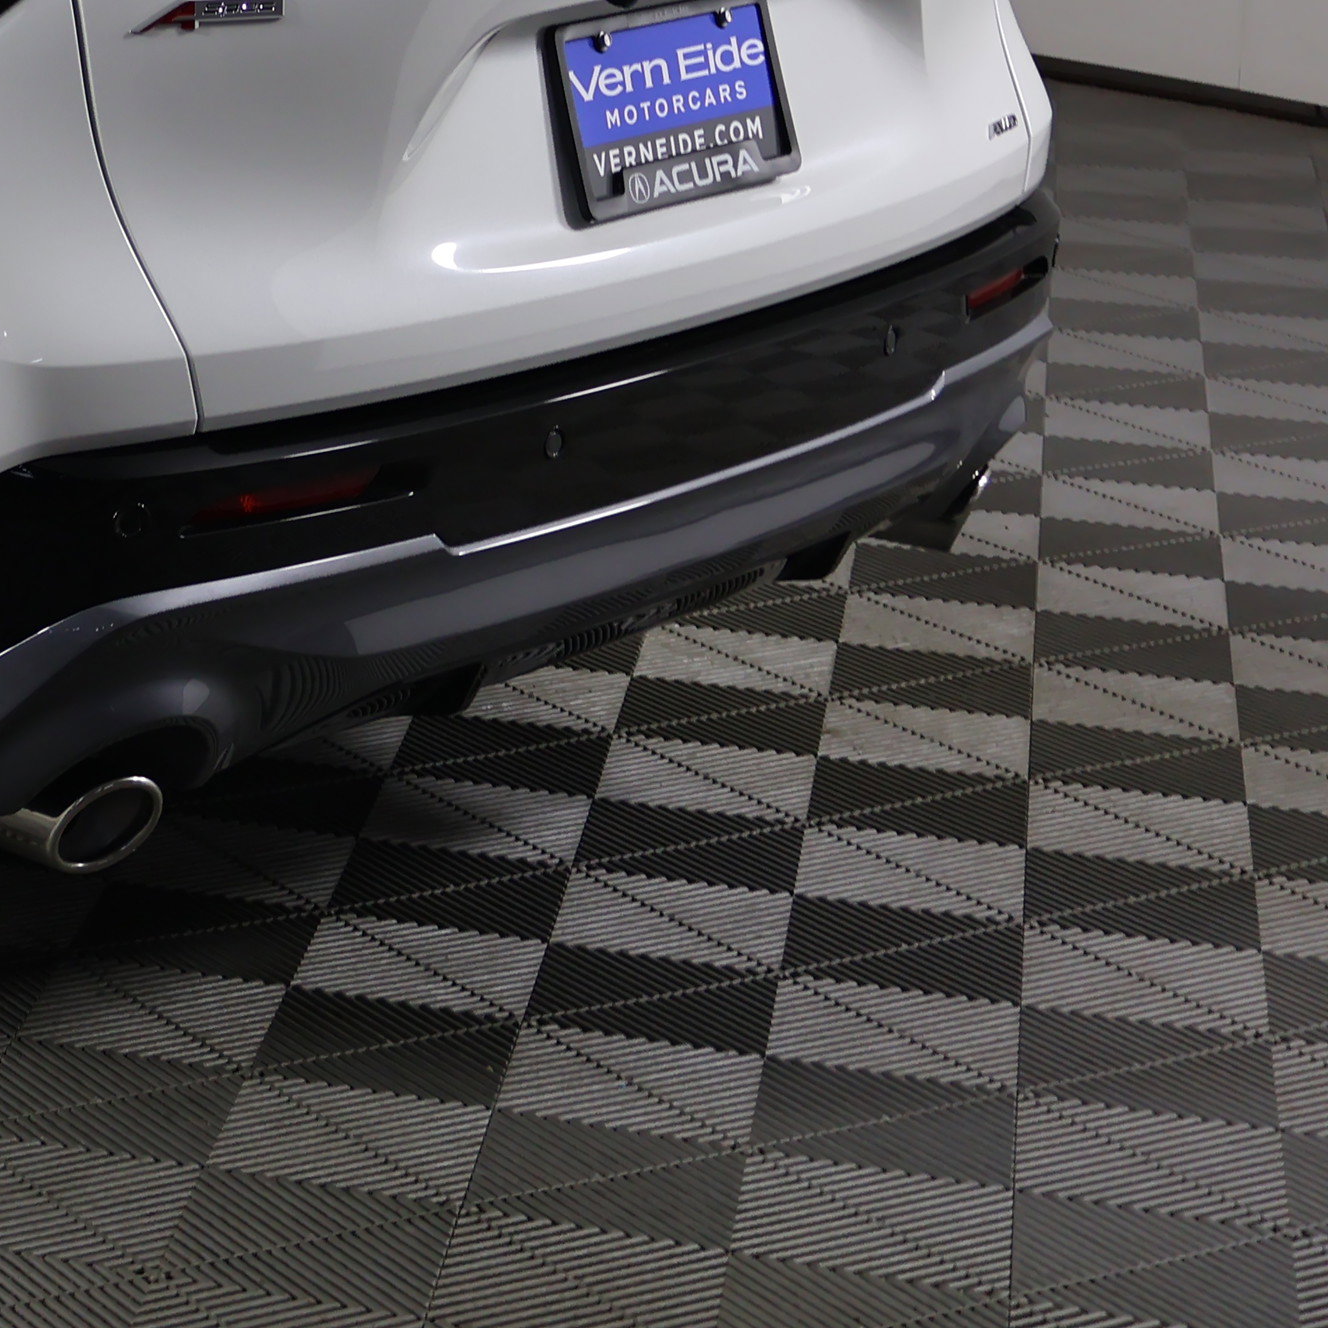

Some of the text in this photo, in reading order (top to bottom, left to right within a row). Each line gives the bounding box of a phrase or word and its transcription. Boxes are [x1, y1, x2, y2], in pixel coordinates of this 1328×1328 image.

[569, 36, 765, 102] Vern Eide
[606, 81, 747, 130] MOTORCARS
[593, 116, 764, 177] VERNEIDE.COM
[653, 149, 760, 198] ACURA
